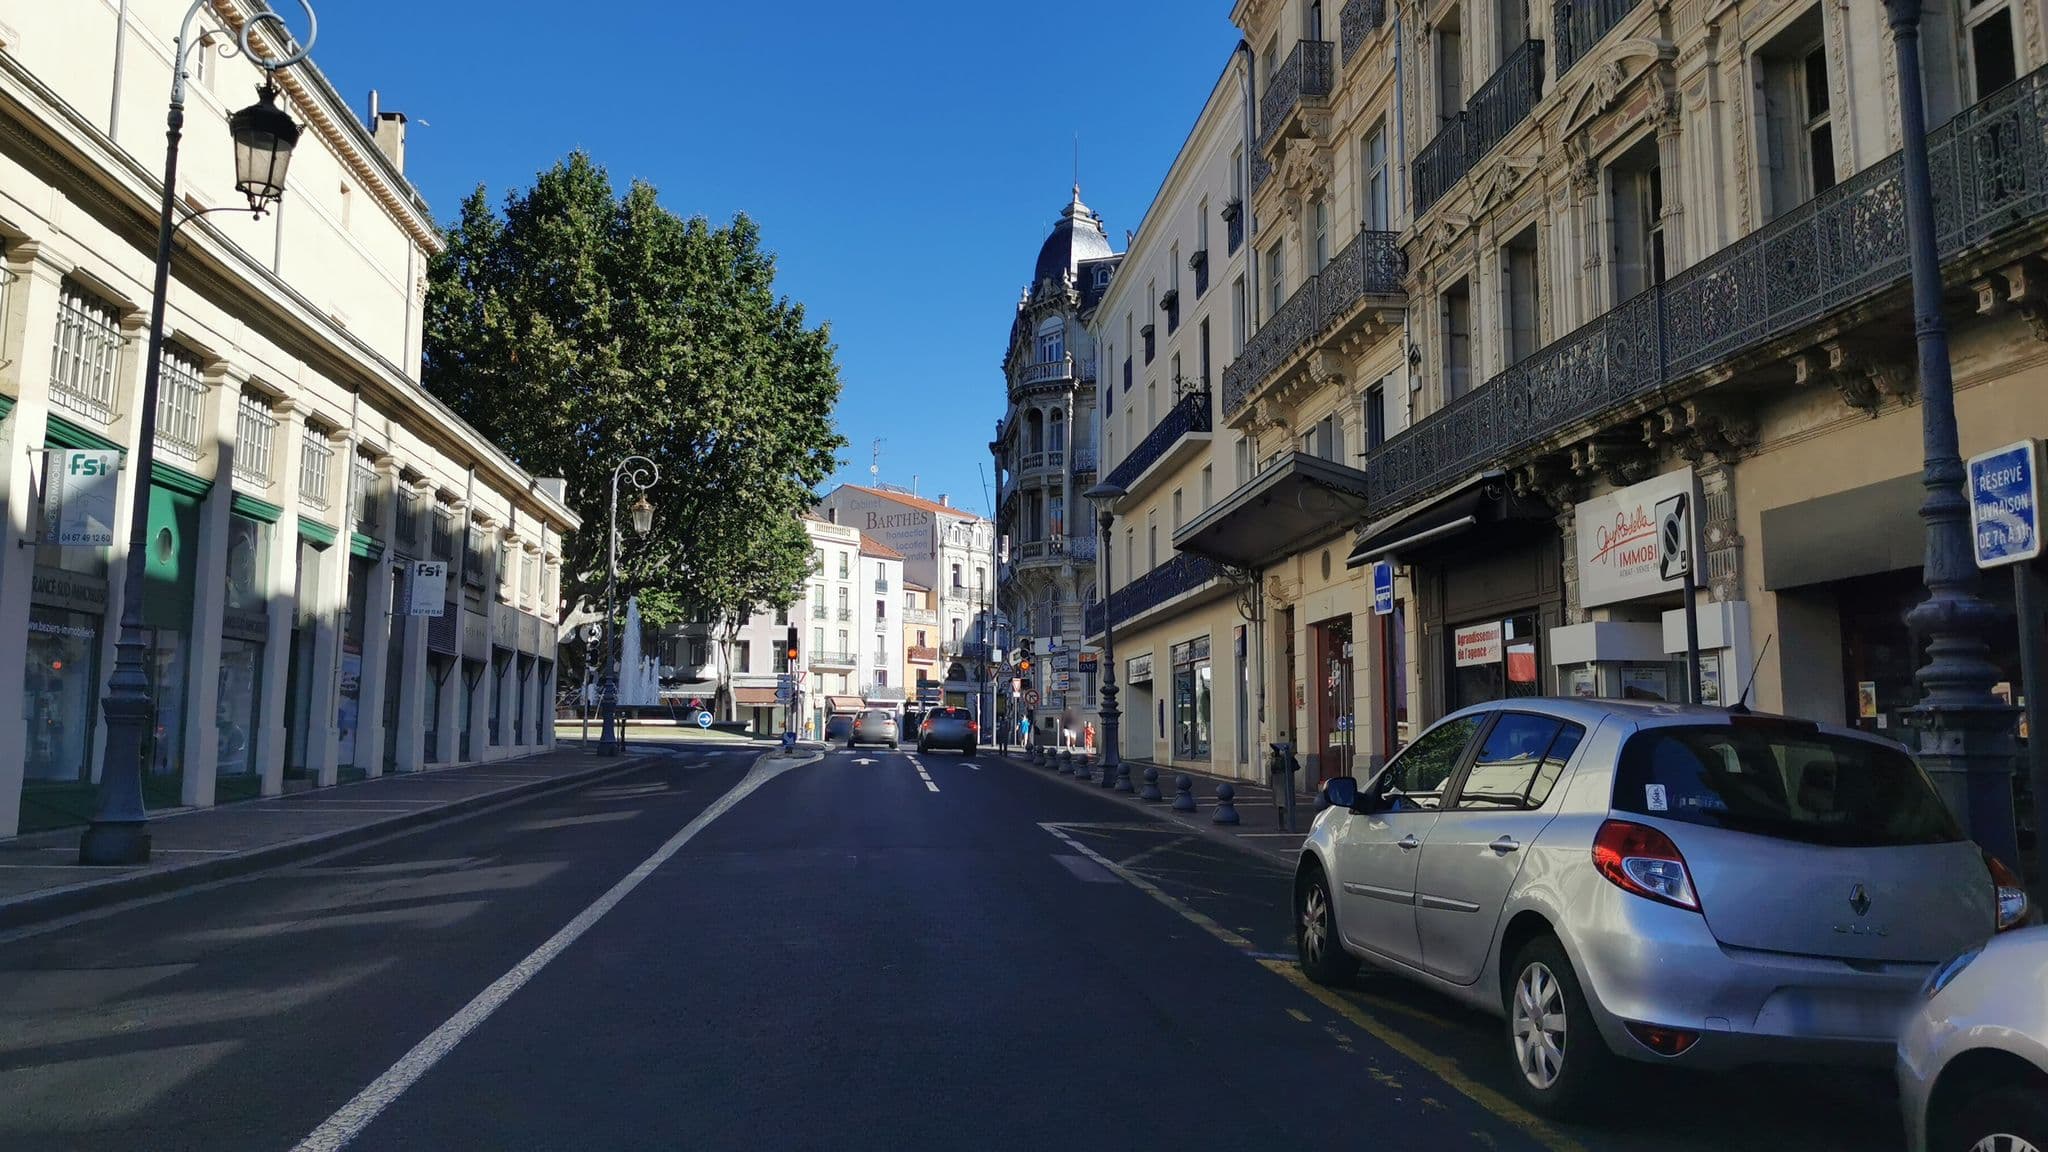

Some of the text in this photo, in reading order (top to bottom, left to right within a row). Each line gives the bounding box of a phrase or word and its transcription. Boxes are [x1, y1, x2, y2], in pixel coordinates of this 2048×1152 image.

[1980, 463, 2023, 492] RÉSERVÉ
[1978, 494, 2028, 521] LIVRAISON
[1979, 531, 1992, 549] DE
[904, 551, 928, 562] yndic
[1619, 543, 1657, 568] IMMOBI
[32, 575, 57, 595] RANCE
[1457, 629, 1500, 646] Agrandissement
[1457, 648, 1464, 660] de
